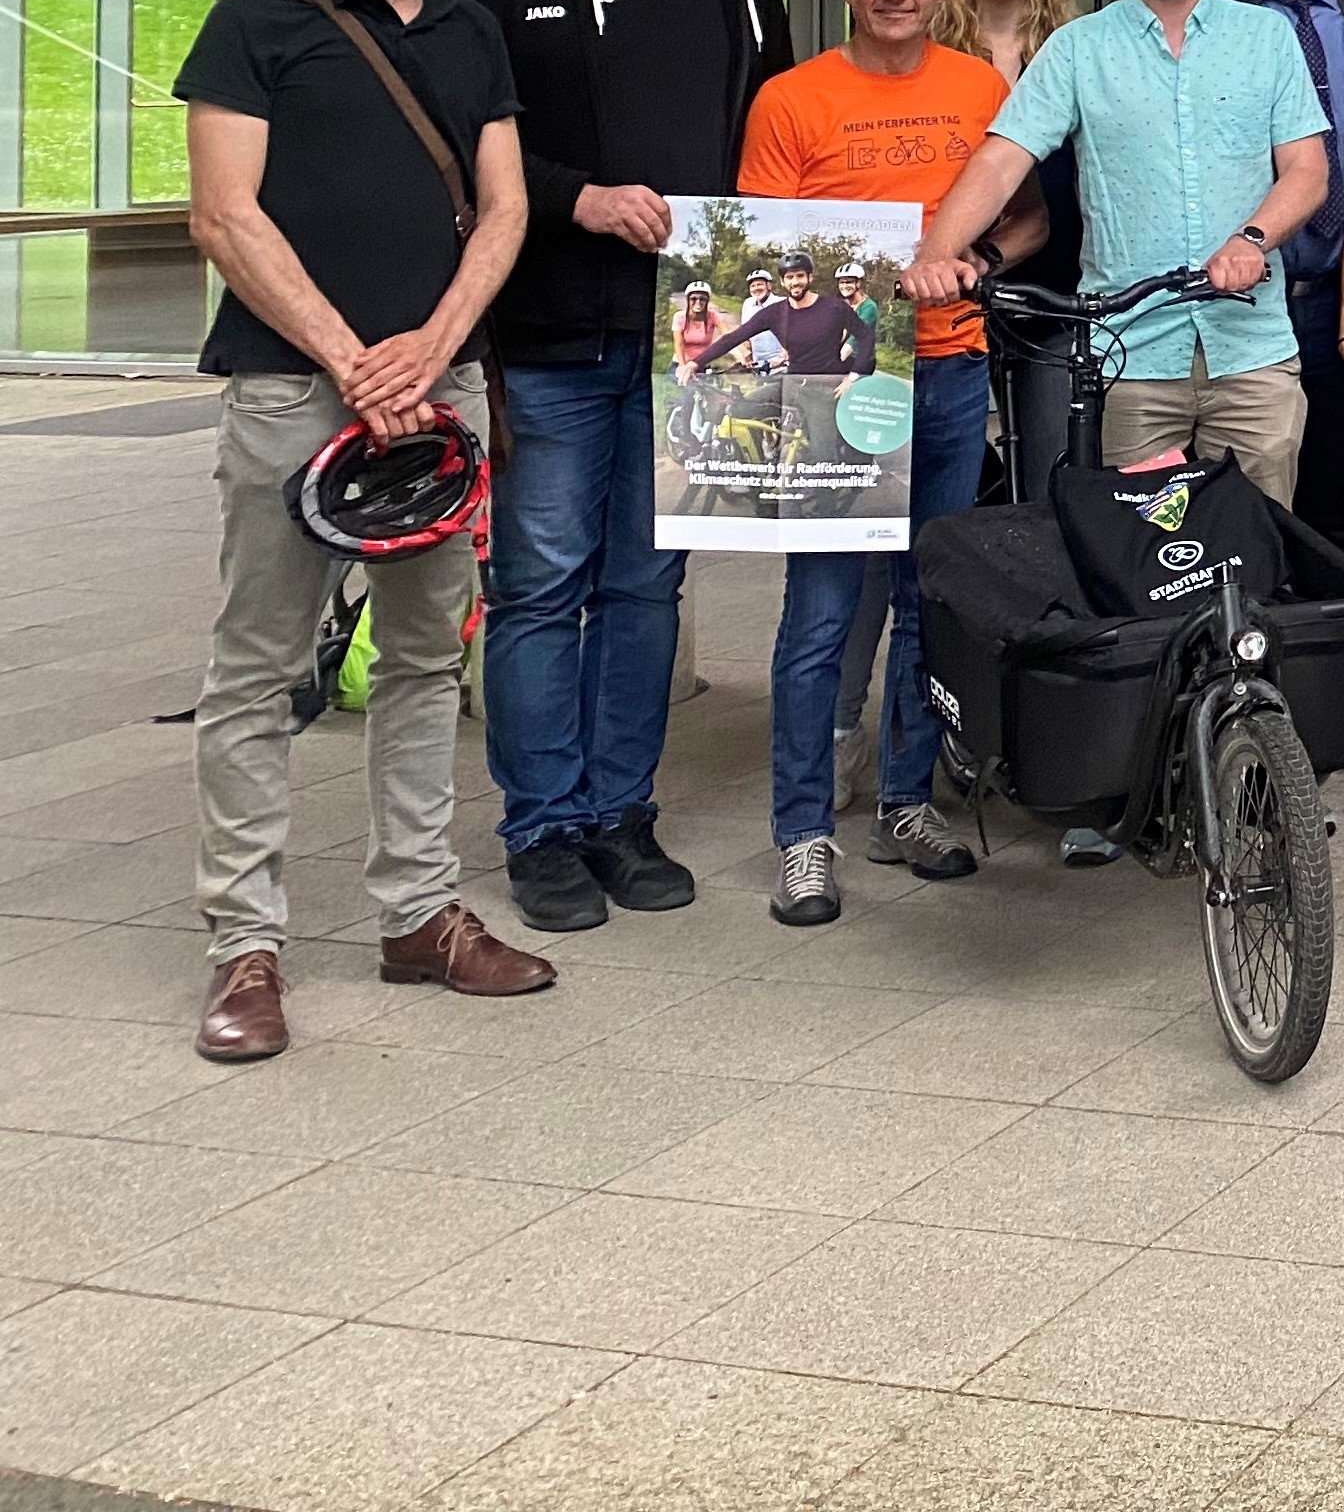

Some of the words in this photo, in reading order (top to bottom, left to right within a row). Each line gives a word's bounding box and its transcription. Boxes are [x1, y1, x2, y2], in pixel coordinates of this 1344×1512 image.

[525, 6, 565, 20] JAKO
[843, 122, 874, 134] MEIN
[877, 117, 940, 130] PERFEKTER
[940, 115, 961, 126] TAG
[825, 218, 914, 231] STADTRADELN
[685, 460, 706, 471] Der
[708, 460, 776, 474] Wettbewerb
[689, 473, 761, 487] Klimaschutz
[762, 477, 784, 488] und
